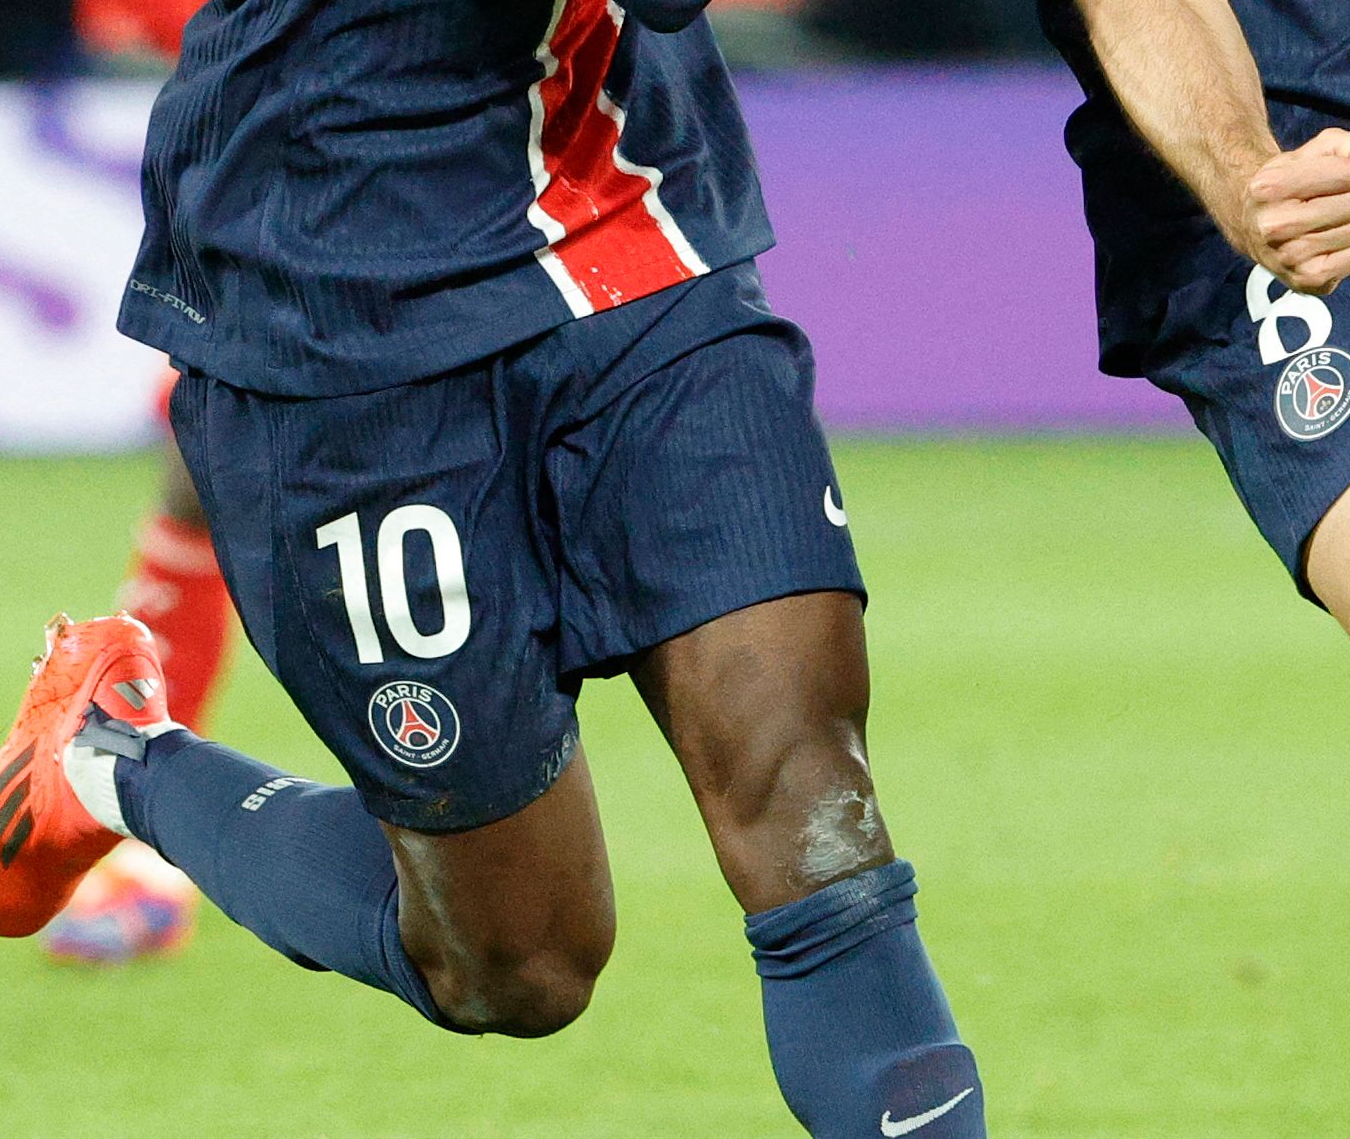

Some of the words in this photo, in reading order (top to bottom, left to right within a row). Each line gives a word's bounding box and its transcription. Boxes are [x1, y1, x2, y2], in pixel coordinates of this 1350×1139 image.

[1246, 263, 1333, 365] 8
[1281, 352, 1331, 395] PARIS
[315, 503, 472, 664] 10
[375, 684, 433, 709] PARIS
